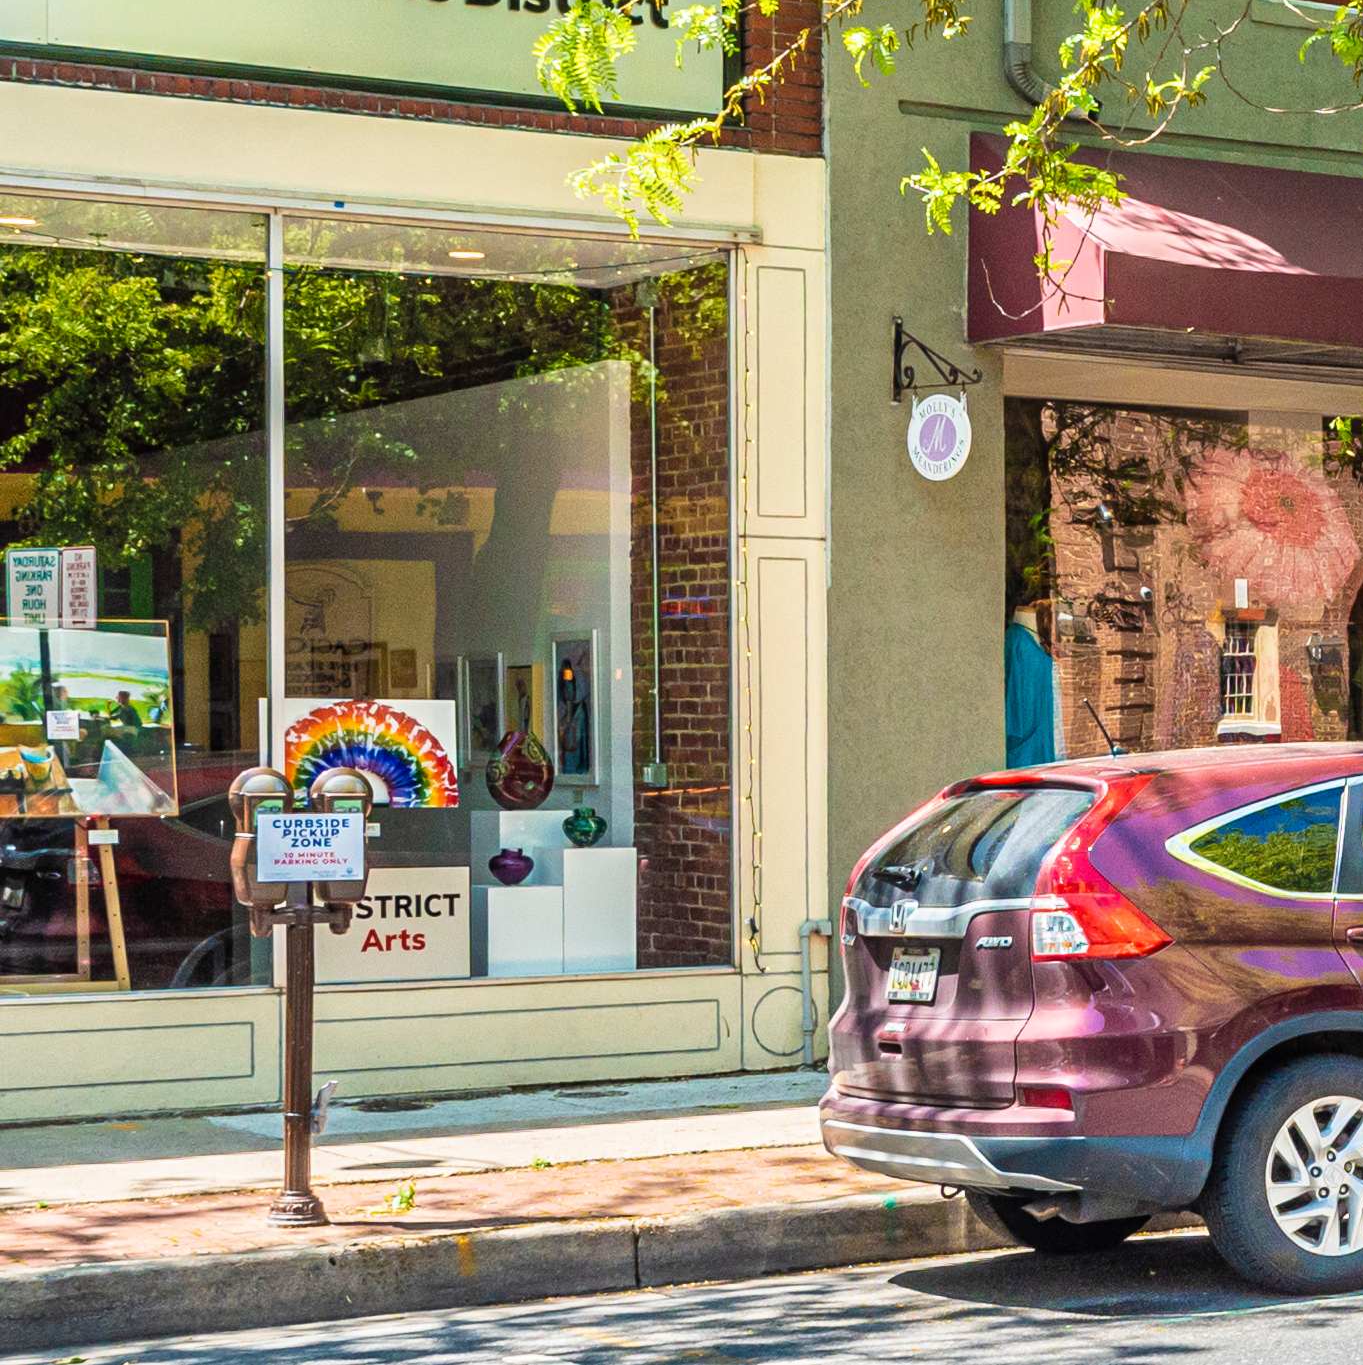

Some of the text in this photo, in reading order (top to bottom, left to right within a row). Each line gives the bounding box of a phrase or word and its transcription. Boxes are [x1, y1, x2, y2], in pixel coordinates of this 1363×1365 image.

[272, 818, 350, 828] CURBSIDE
[282, 828, 340, 838] PICKUP
[291, 838, 332, 847] ZONE
[351, 893, 460, 920] STRICT
[361, 928, 426, 952] Arts
[976, 936, 1014, 948] AWD
